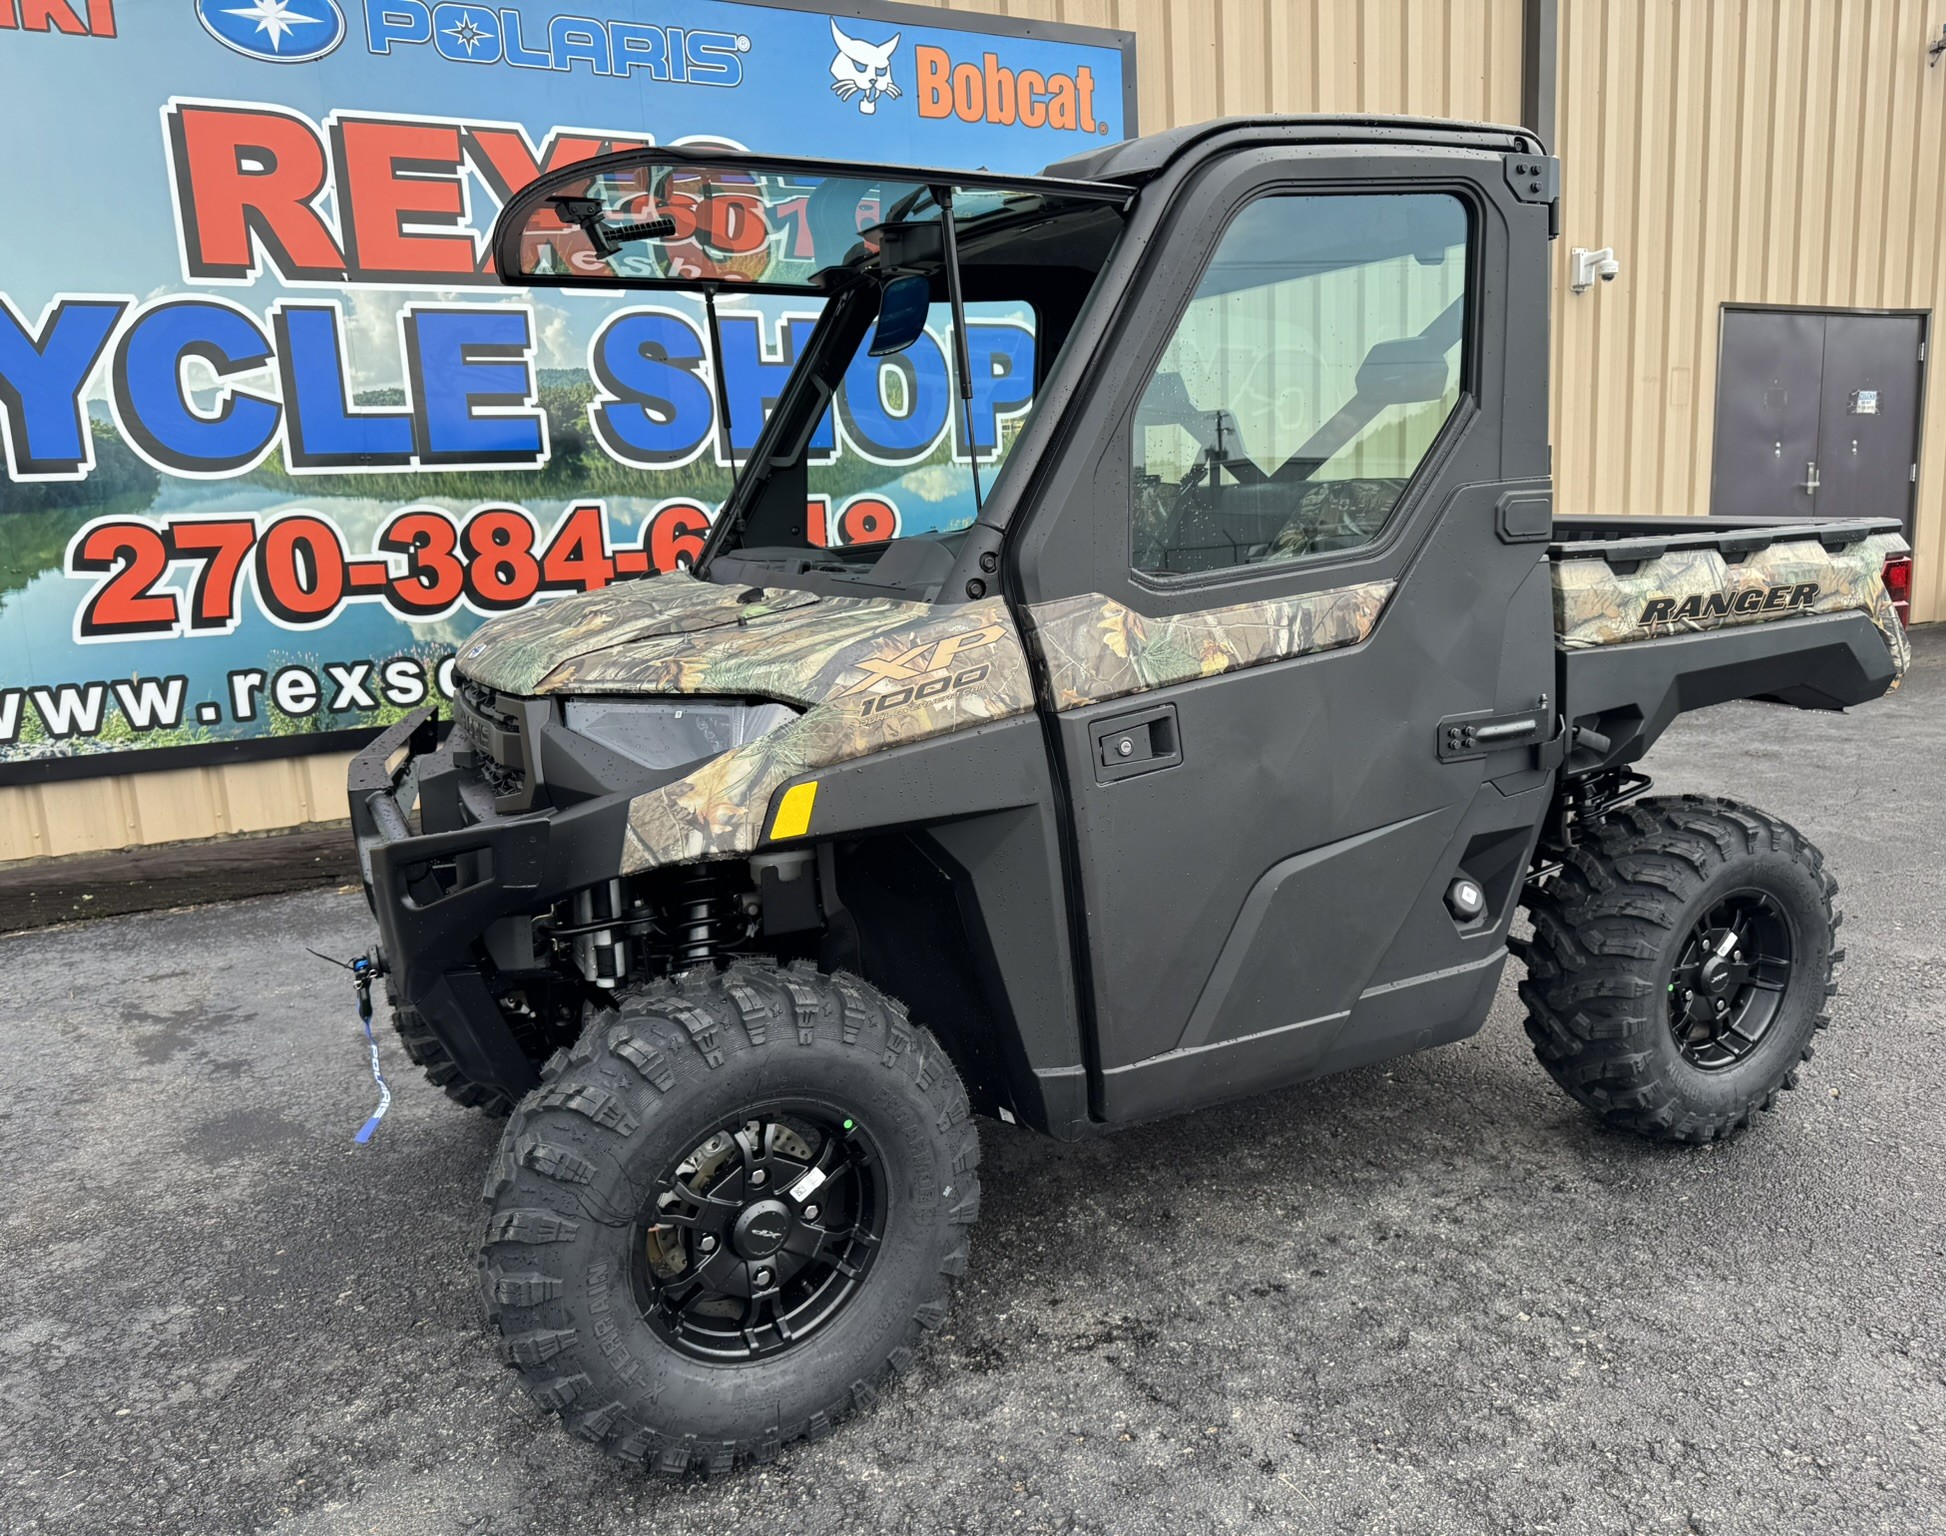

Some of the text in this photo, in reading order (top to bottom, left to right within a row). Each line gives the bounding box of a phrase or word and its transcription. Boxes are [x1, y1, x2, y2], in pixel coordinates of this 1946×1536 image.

[1638, 582, 1820, 627] RANGER
[831, 624, 1008, 700] XP
[860, 662, 991, 718] 1000
[371, 1043, 392, 1120] POLARIS
[586, 1261, 668, 1405] X-TERRAIN
